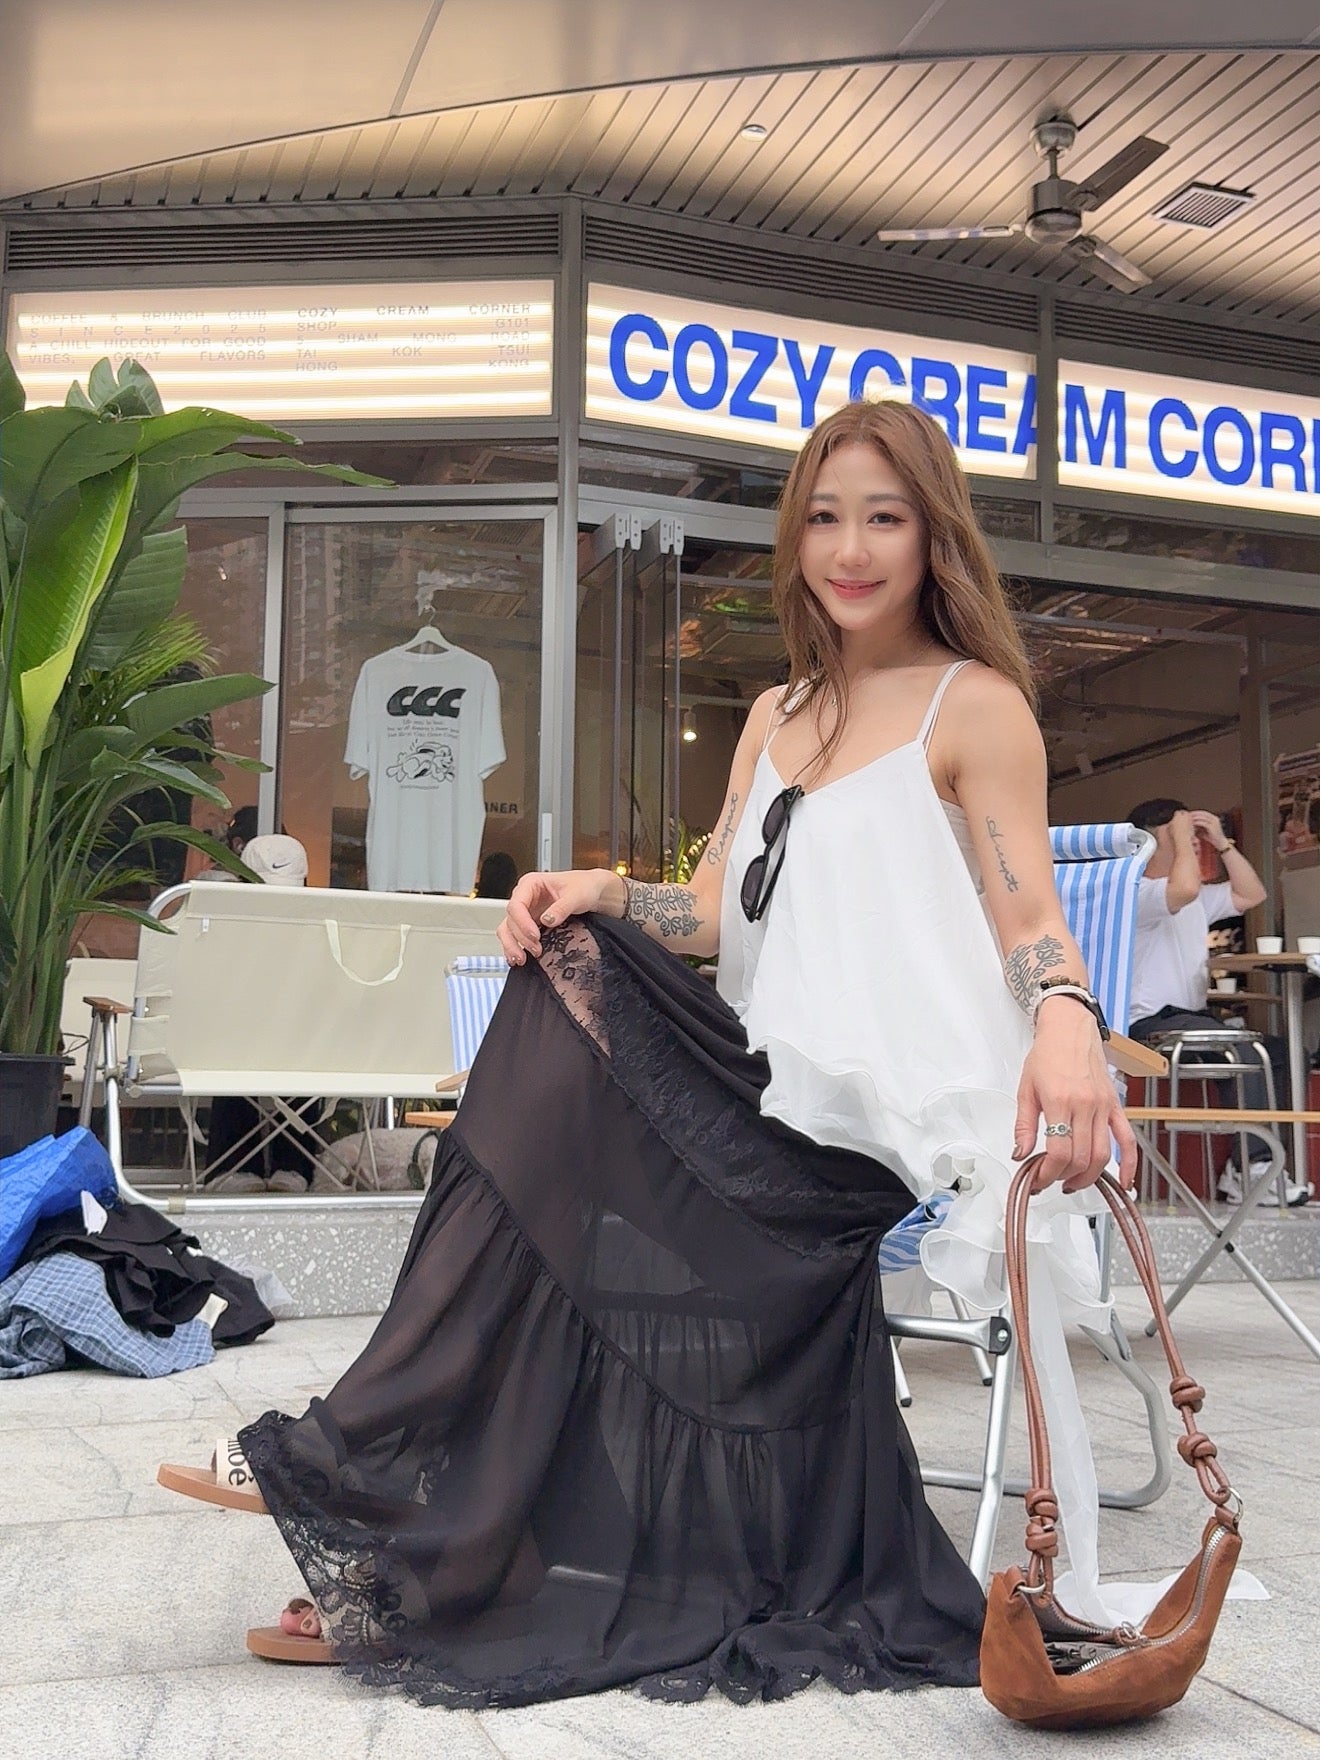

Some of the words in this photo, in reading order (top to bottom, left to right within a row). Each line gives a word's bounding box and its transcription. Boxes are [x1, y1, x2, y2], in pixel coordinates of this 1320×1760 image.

[31, 312, 89, 324] COFFEE
[142, 310, 205, 321] BRUNCH
[227, 308, 267, 320] CLUB
[297, 306, 338, 318] COZY
[376, 304, 429, 316] CREAM
[468, 303, 531, 315] CORNER
[296, 321, 338, 332] SHOP
[495, 317, 529, 328] G101
[49, 339, 92, 351] CHILL
[103, 337, 169, 348] HIDEOUT
[182, 337, 212, 347] FOR
[223, 336, 267, 347] GOOD
[337, 332, 378, 343] SHAM
[412, 331, 457, 342] MONG
[28, 352, 76, 364] VIBES,
[112, 351, 161, 362] GREAT
[200, 349, 266, 361] FLAVORS
[297, 348, 317, 359] TAI
[392, 346, 422, 357] KOK
[498, 344, 530, 356] TSUI
[295, 361, 338, 372] HONG
[488, 358, 529, 368] KONG
[610, 313, 836, 430] COZY
[1148, 397, 1320, 494] COR
[386, 685, 467, 719] CCC
